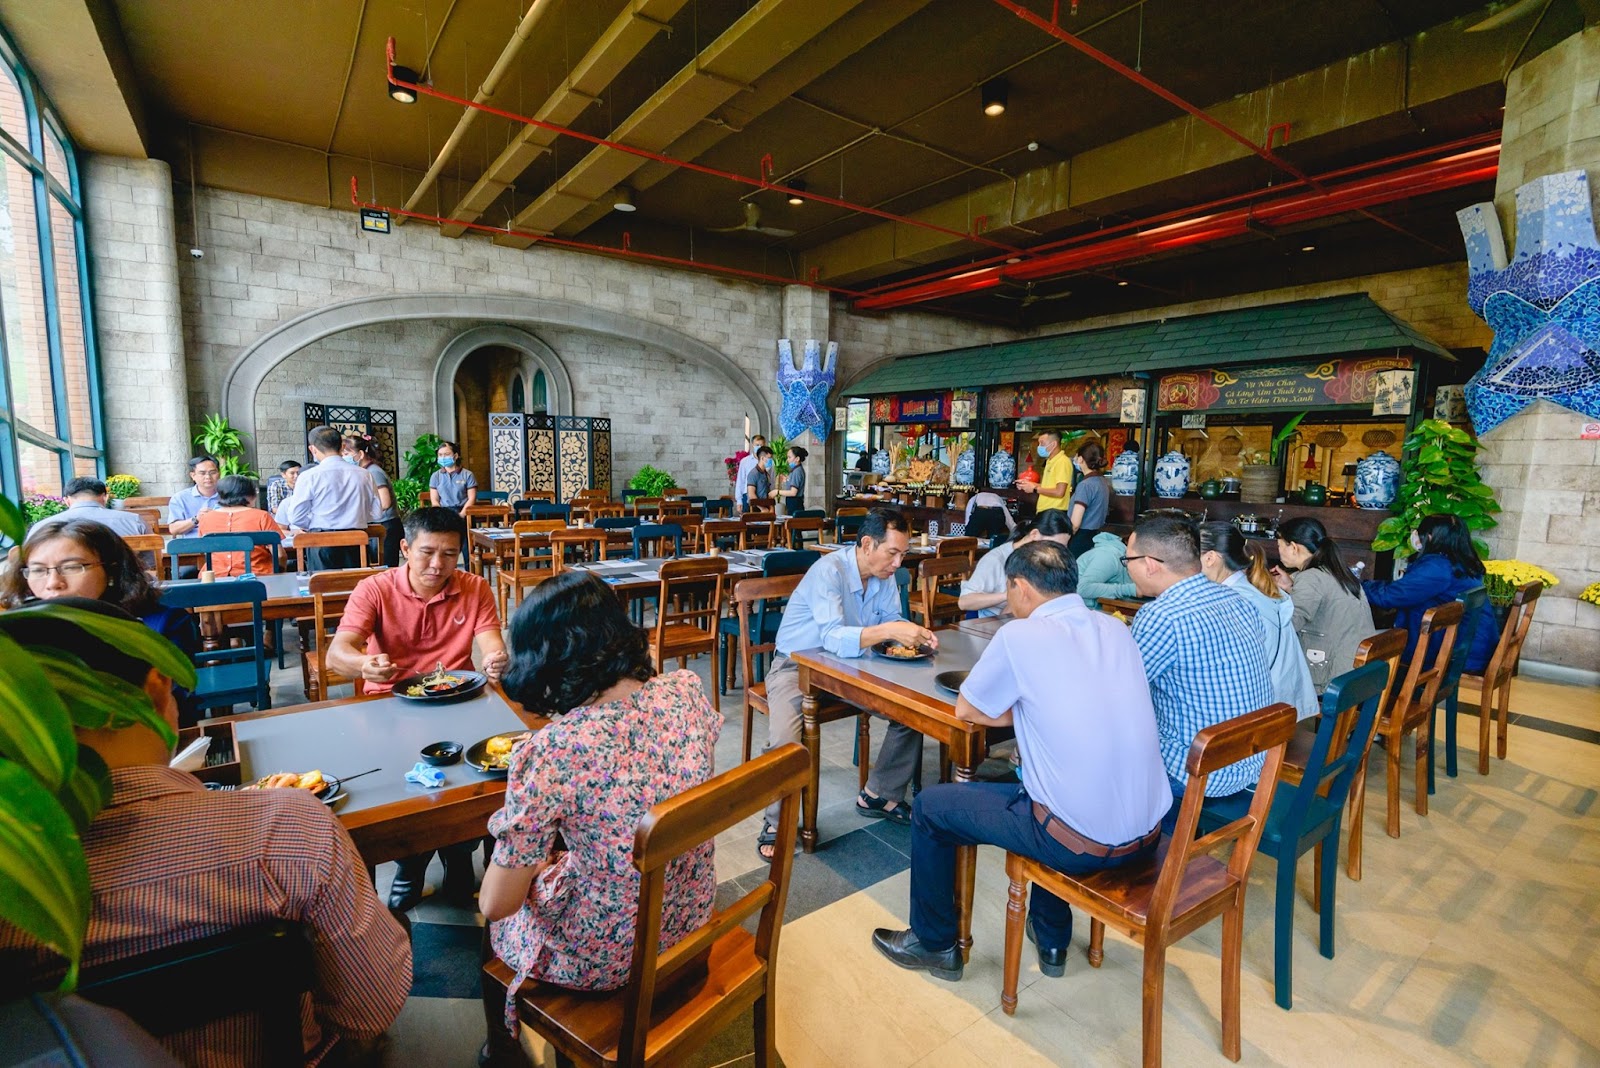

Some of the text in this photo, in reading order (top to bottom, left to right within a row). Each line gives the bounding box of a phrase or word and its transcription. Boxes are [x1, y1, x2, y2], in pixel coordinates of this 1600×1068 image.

[1276, 379, 1297, 387] Chao
[1039, 393, 1073, 414] CÁ BASA
